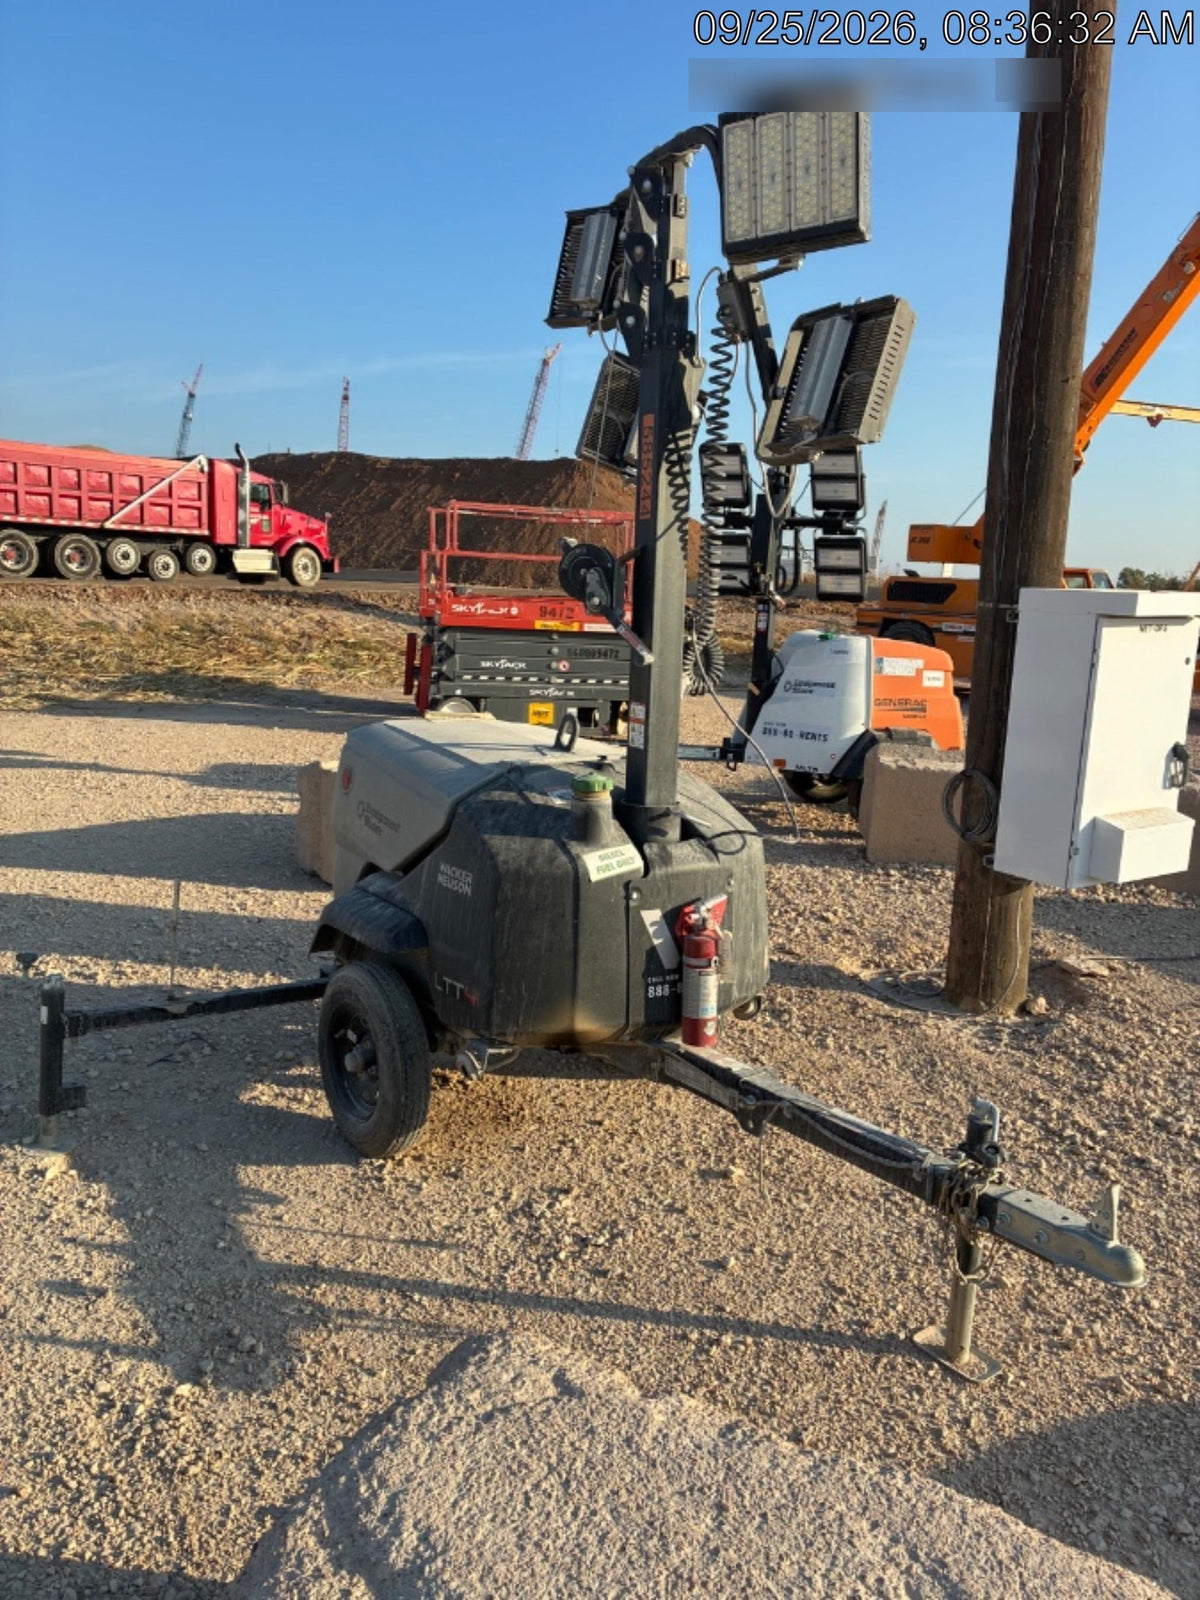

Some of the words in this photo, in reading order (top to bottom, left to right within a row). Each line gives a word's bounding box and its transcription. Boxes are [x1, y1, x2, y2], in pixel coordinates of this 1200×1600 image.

[480, 659, 527, 671] SKYJACK
[874, 698, 927, 707] GENERAC
[440, 863, 473, 881] WACKER
[596, 861, 617, 875] FUEL
[437, 873, 472, 896] NEUSON
